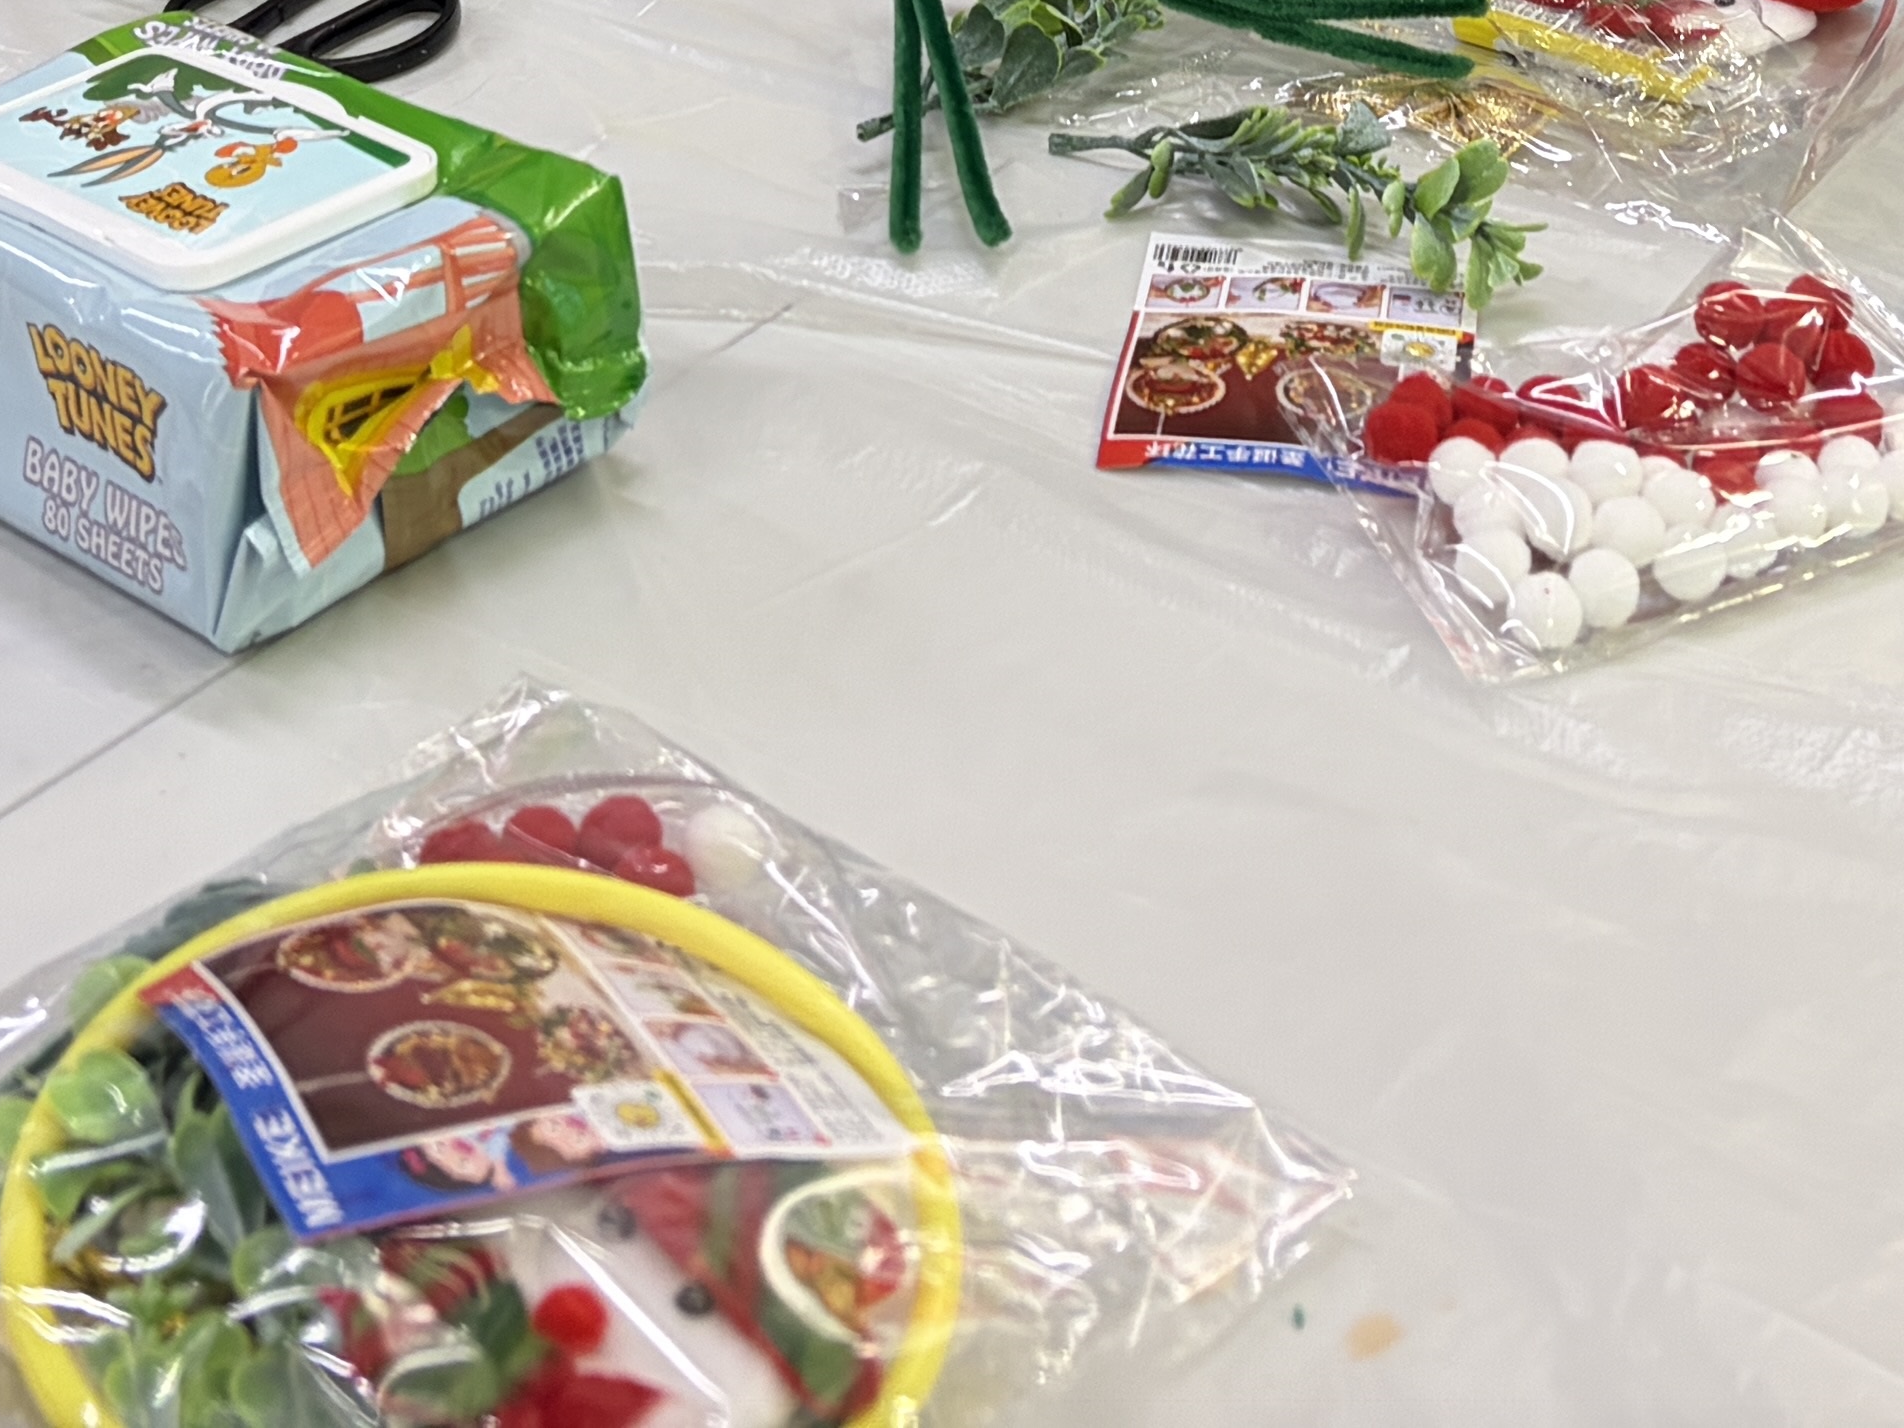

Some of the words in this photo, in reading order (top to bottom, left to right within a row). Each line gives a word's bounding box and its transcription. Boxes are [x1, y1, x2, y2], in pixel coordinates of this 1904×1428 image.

[26, 321, 168, 430] LOONEY
[46, 376, 158, 484] TUNES
[23, 434, 99, 513] BABY
[104, 479, 188, 572] WIPES
[42, 499, 71, 541] 80
[74, 516, 164, 594] SHEETS
